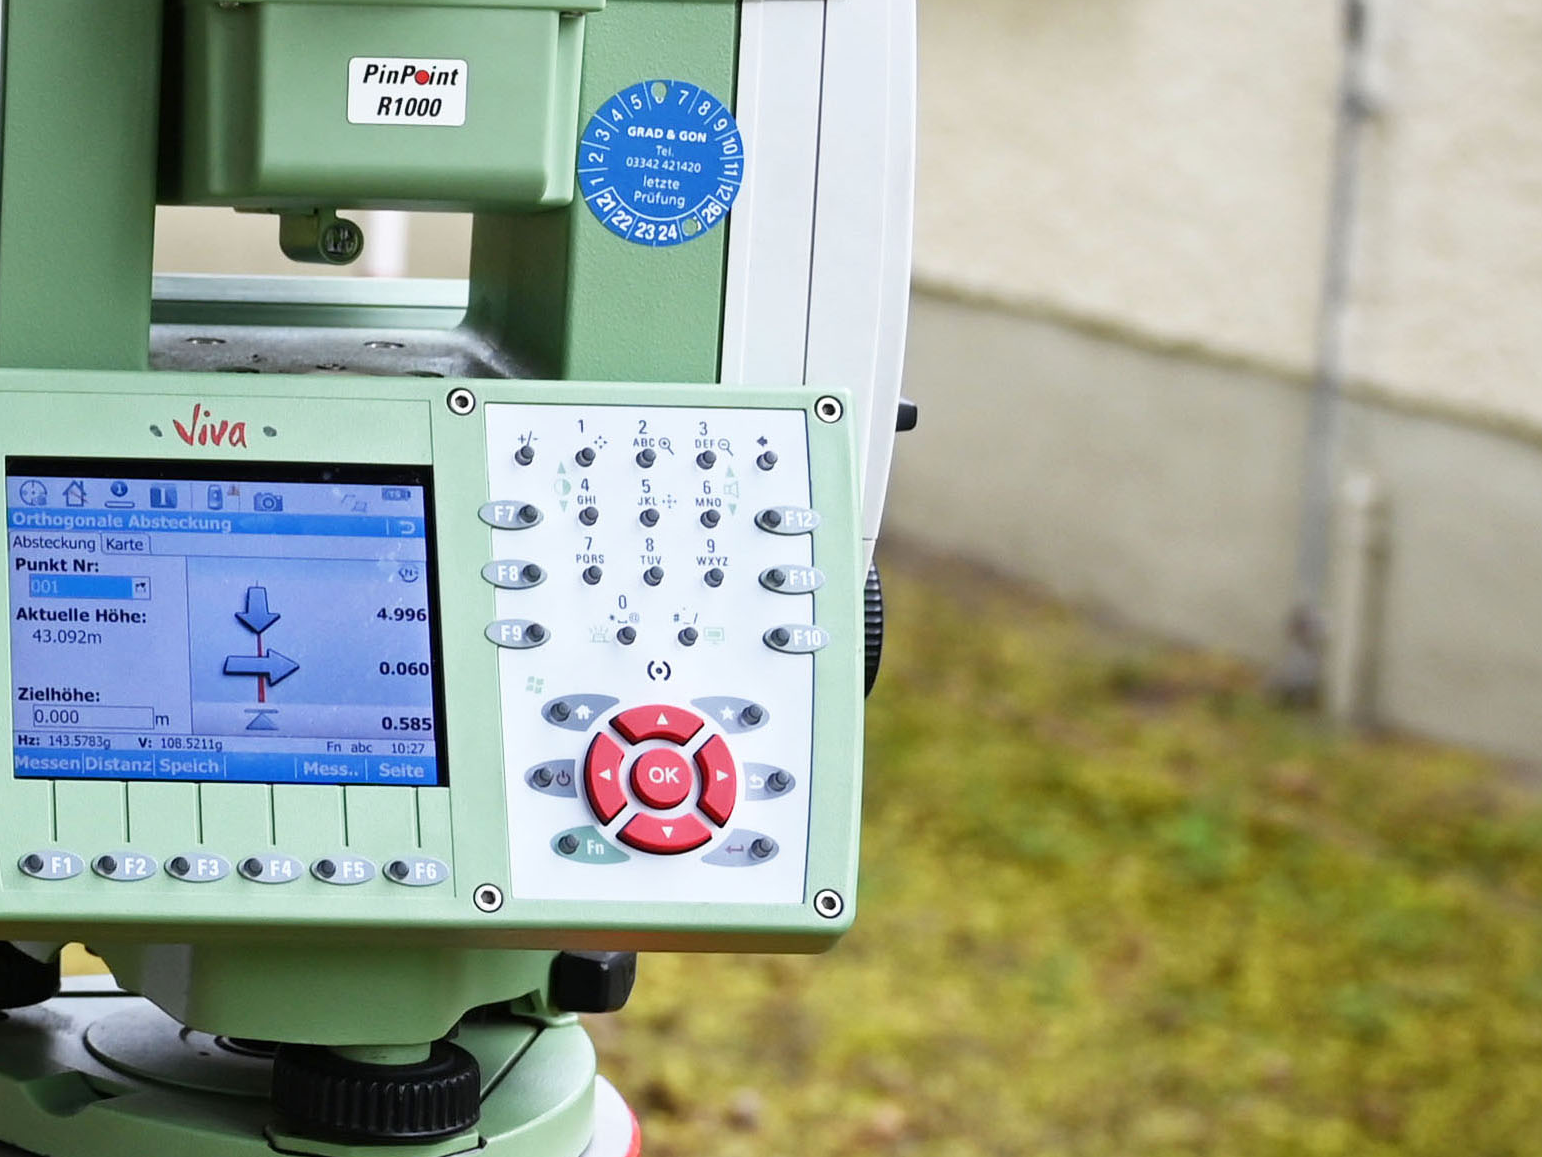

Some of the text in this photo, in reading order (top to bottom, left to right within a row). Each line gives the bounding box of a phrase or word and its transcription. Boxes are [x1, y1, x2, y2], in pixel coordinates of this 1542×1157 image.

[630, 94, 643, 110] 5
[678, 89, 689, 105] 7
[377, 96, 442, 117] R1000
[697, 100, 711, 116] 8
[611, 108, 624, 122] 4
[713, 118, 728, 132] 9
[595, 128, 610, 141] 3
[628, 126, 707, 143] GRAD & GON
[656, 145, 675, 156] Tel.
[722, 137, 738, 155] 10
[588, 152, 604, 163] 2
[626, 157, 702, 173] 03342 421420
[724, 162, 739, 176] 11
[590, 177, 604, 186] 1
[643, 175, 680, 190] letzte
[634, 191, 686, 209] Prüfung
[716, 184, 734, 202] 12
[596, 193, 616, 212] 21
[611, 211, 633, 231] 22
[635, 222, 655, 241] 23
[658, 224, 677, 241] 24
[701, 202, 722, 223] 26
[172, 403, 247, 448] Viva
[578, 419, 584, 433] 1
[638, 420, 647, 435] 2
[699, 421, 708, 436] 3
[632, 438, 655, 447] ABC
[695, 439, 715, 449] DEF
[581, 478, 589, 492] 4
[642, 479, 651, 494] 5
[703, 480, 711, 494] 6
[577, 495, 596, 505] GHI
[637, 496, 658, 506] JKL
[695, 497, 722, 508] MNO
[493, 505, 515, 522] F7
[784, 512, 813, 527] F12
[12, 512, 232, 532] Orthogonale Absteckung
[13, 536, 96, 553] Absteckung
[106, 538, 143, 551] Karte
[584, 536, 593, 551] 7
[645, 537, 654, 552] 8
[706, 539, 715, 553] 9
[15, 558, 99, 572] Punkt Nr:
[576, 554, 605, 564] PQRS
[640, 555, 662, 565] TUV
[696, 556, 729, 566] WXYZ
[497, 565, 519, 582] F8
[789, 570, 815, 586] F11
[31, 579, 59, 593] 001
[618, 594, 627, 610] 0
[16, 607, 147, 624] Aktuelle Höhe:
[376, 608, 427, 622] 4.996
[32, 629, 102, 644] 43.092m
[500, 625, 522, 641] F9
[793, 629, 822, 645] F10
[379, 662, 429, 676] 0.060
[18, 687, 100, 702] Zielhöhe:
[34, 709, 169, 726] 0.000 m
[382, 717, 432, 731] 0.585
[18, 735, 425, 754] Hz: 143.5783g V: 108.5211g Fn abc 10:27
[15, 755, 425, 778] Messen Distanz Speich Mess.. Seite
[648, 766, 680, 784] OK
[586, 839, 604, 855] Fn
[52, 857, 71, 874] F1
[124, 857, 146, 875] F2
[197, 859, 219, 877] F3
[270, 859, 292, 877] F4
[342, 860, 365, 878] F5
[415, 862, 437, 879] F6
